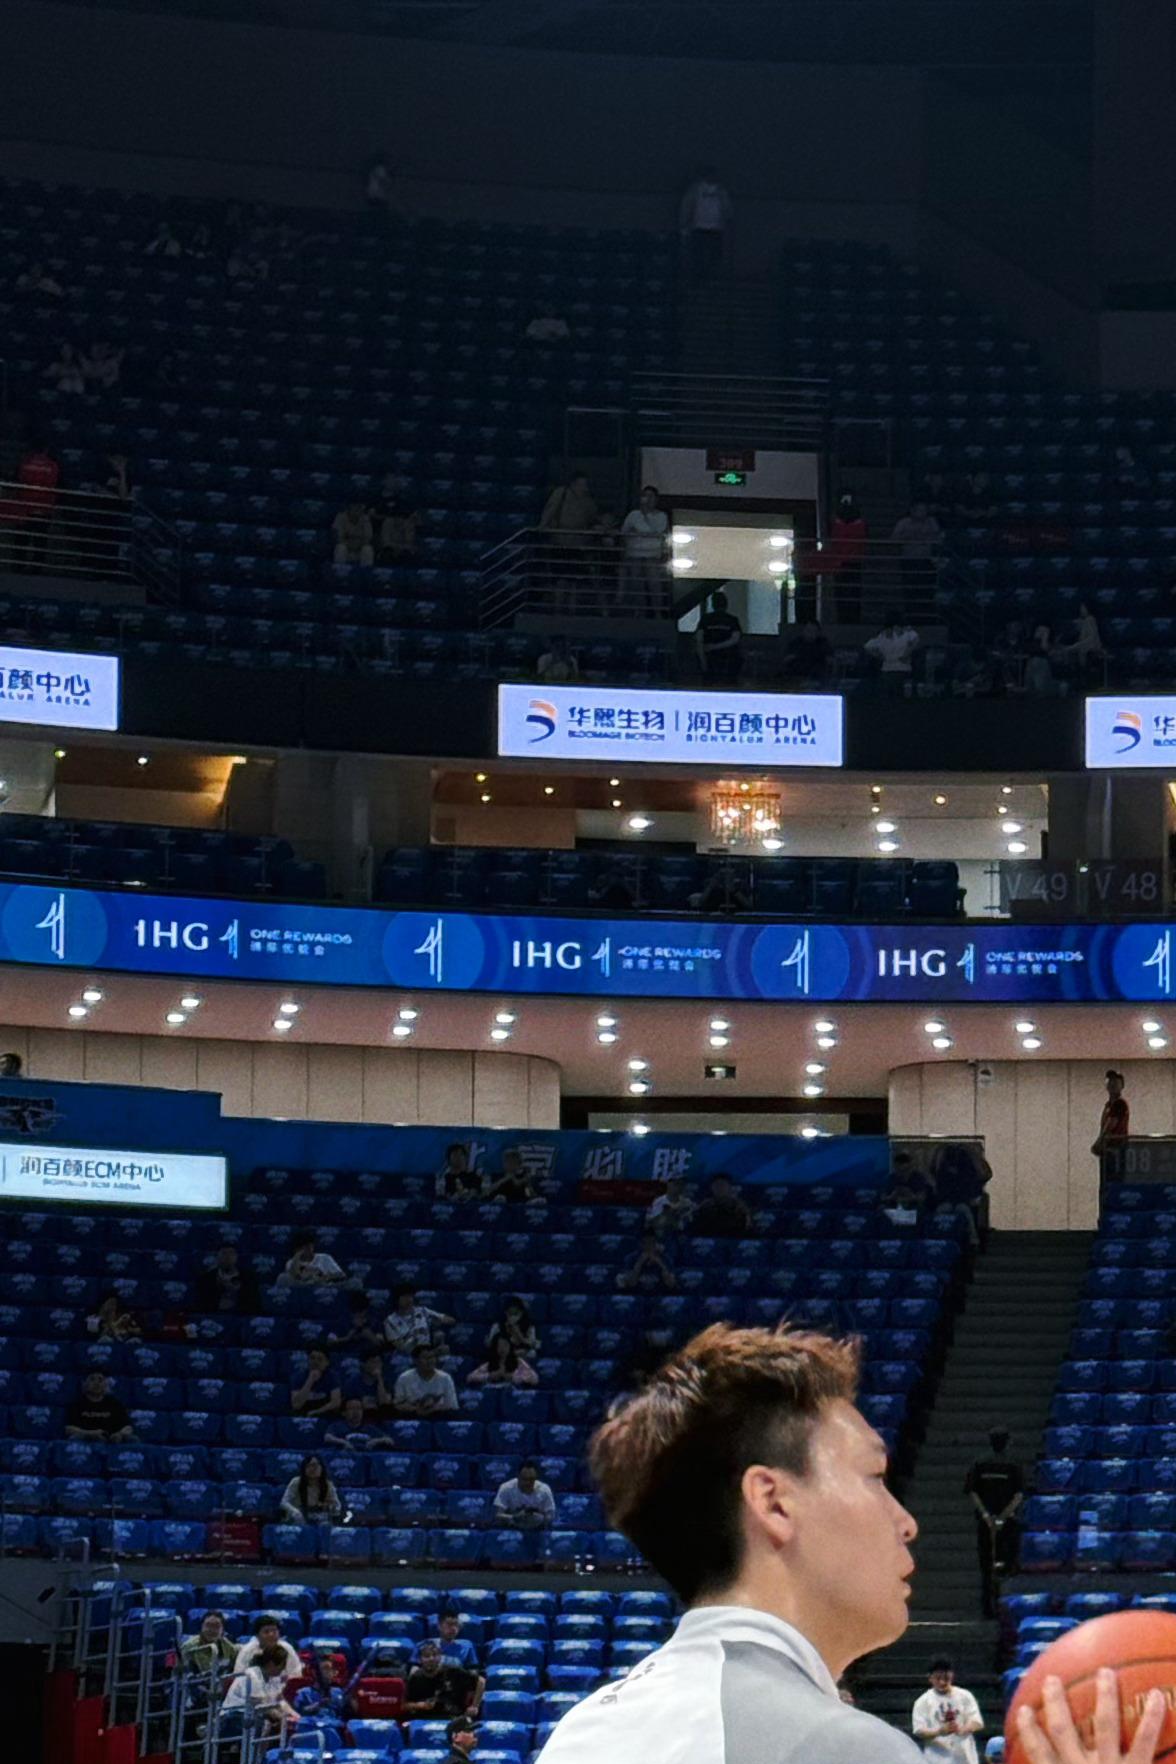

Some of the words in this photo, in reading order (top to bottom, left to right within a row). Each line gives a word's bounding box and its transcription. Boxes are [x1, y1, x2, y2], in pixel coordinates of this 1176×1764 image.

[568, 706, 665, 731] 华熙生物
[687, 711, 816, 737] 润百颜中心
[1031, 872, 1067, 901] 49
[1120, 872, 1158, 900] 48
[135, 919, 209, 950] IHG
[250, 928, 280, 940] ONE
[282, 930, 352, 945] REWARDS
[512, 940, 582, 970] IHG
[621, 946, 651, 958] ONE
[654, 946, 722, 960] REWARDS
[879, 949, 946, 977] IHG
[985, 951, 1015, 962] ONE
[1017, 951, 1084, 962] REWARDS
[20, 1156, 164, 1183] 润百颜ECM中心
